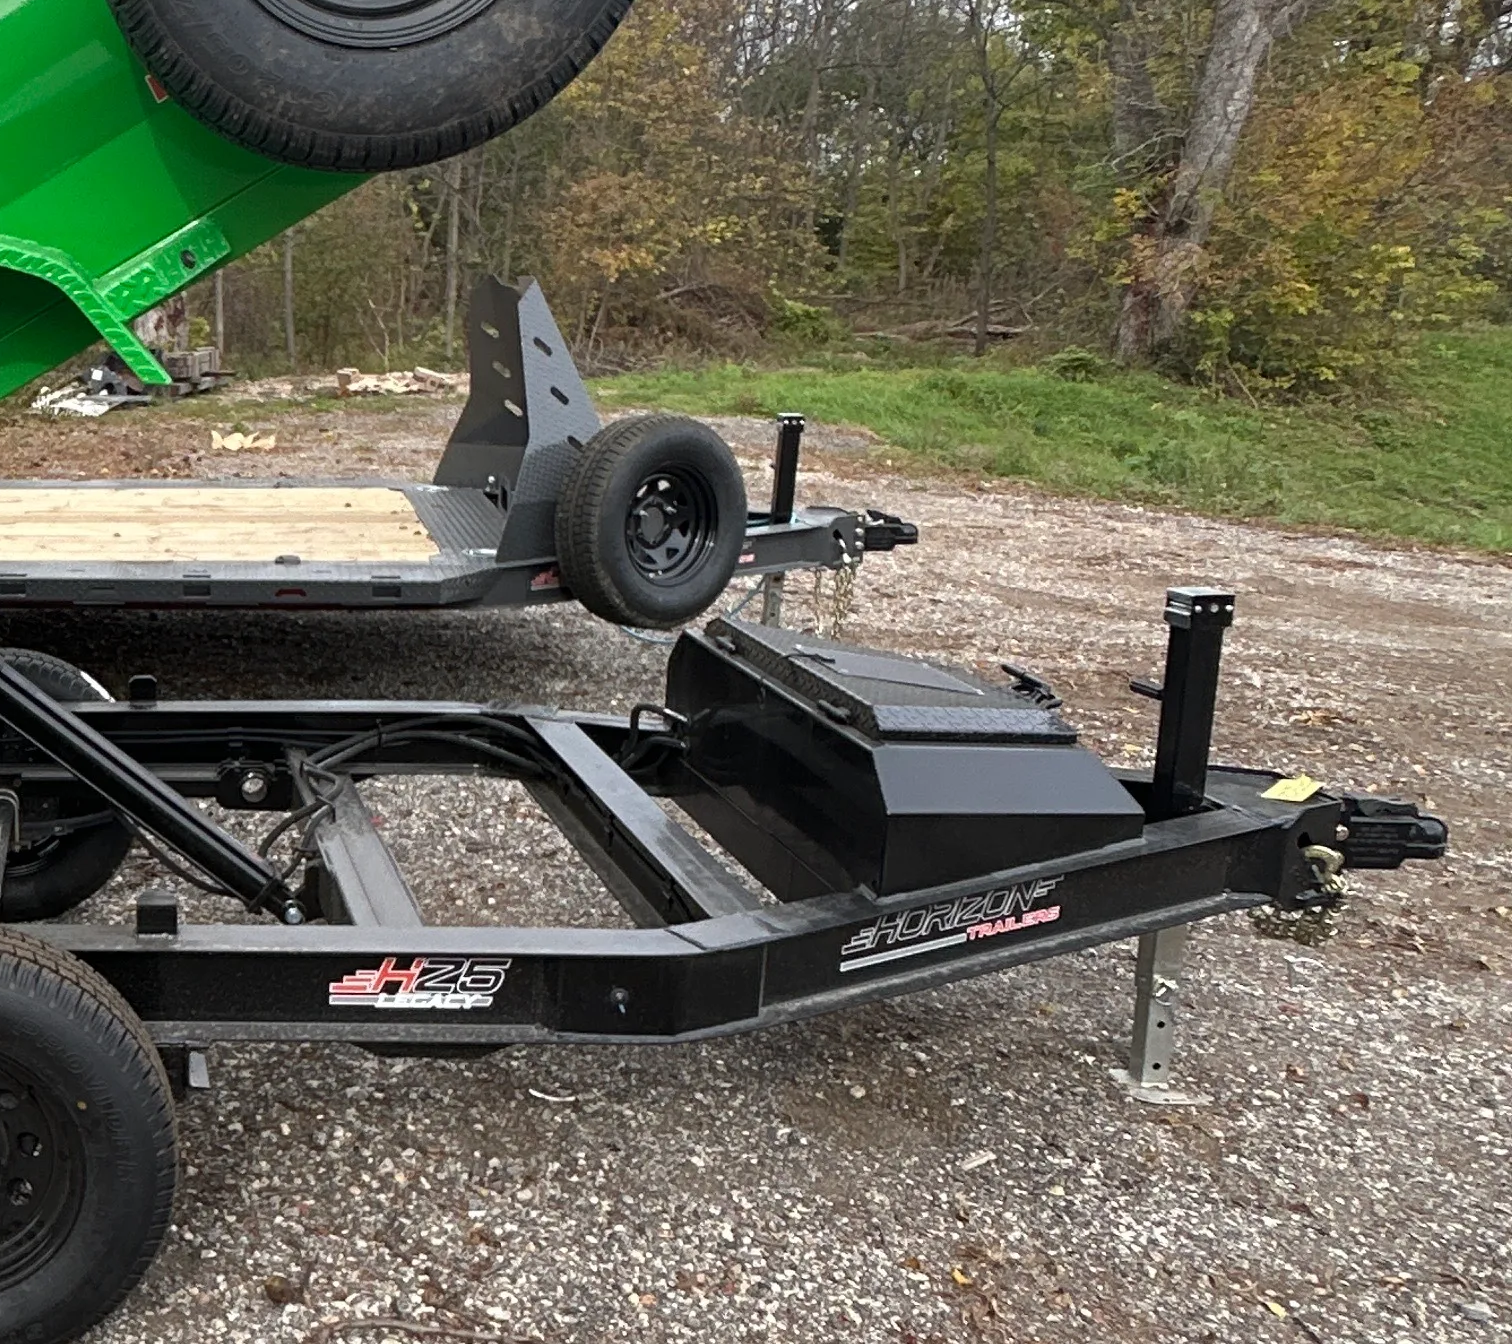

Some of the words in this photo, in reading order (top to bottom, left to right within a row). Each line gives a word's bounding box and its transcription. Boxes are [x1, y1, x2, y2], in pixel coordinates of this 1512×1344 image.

[868, 878, 1038, 949] HORIZON
[967, 906, 1061, 940] TRAILERS
[375, 993, 483, 1010] LEGACY
